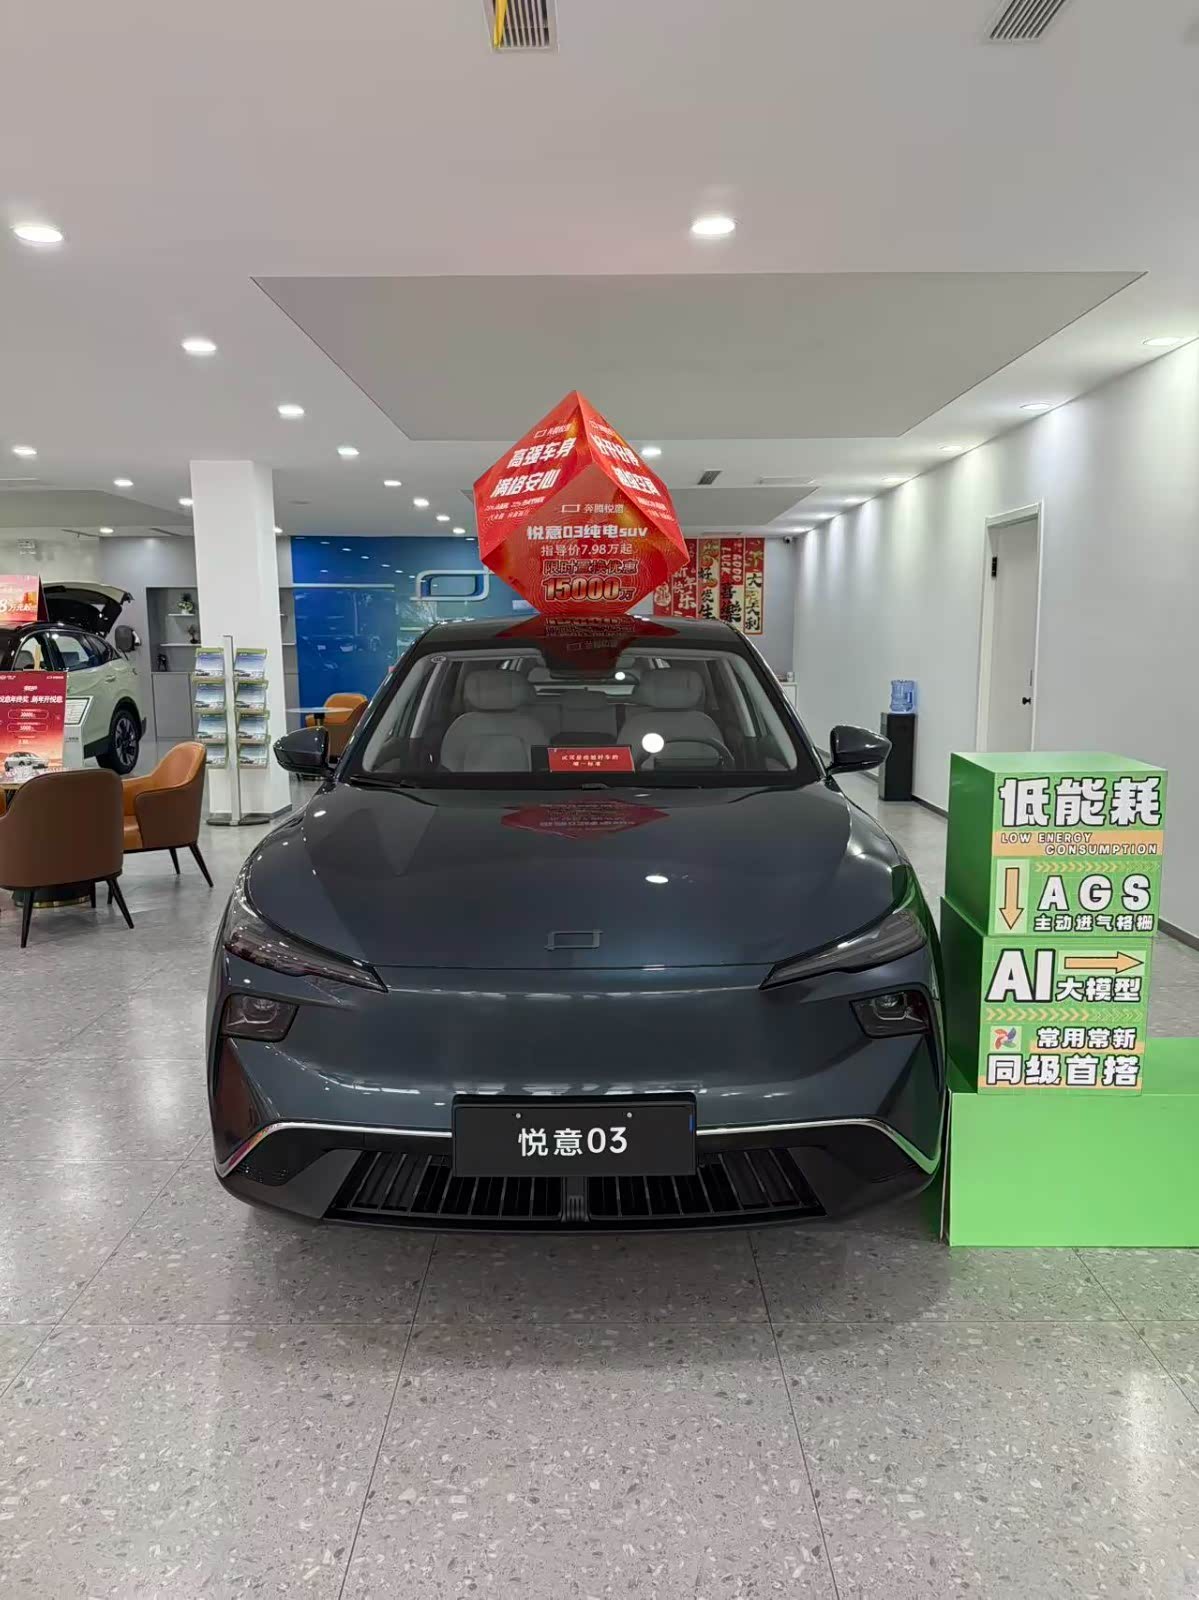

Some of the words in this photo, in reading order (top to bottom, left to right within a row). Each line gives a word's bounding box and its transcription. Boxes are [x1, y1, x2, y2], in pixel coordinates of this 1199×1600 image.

[507, 437, 577, 469] 高强车身
[541, 543, 633, 557] 指导价7.98万起
[542, 559, 639, 576] 限时置换优惠
[732, 553, 742, 583] GOOD
[998, 776, 1162, 828] 低能耗
[1001, 833, 1033, 843] LOW
[1037, 832, 1093, 843] ENERGY
[1045, 843, 1158, 856] CONSUMPTION
[1033, 914, 1155, 932] 主动进气格栅
[985, 948, 1057, 1004] AI
[1056, 976, 1142, 1003] 大模型
[1036, 1026, 1137, 1051] 常用常新
[986, 1053, 1140, 1087] 同级首搭
[517, 1126, 628, 1157] 悦意03
